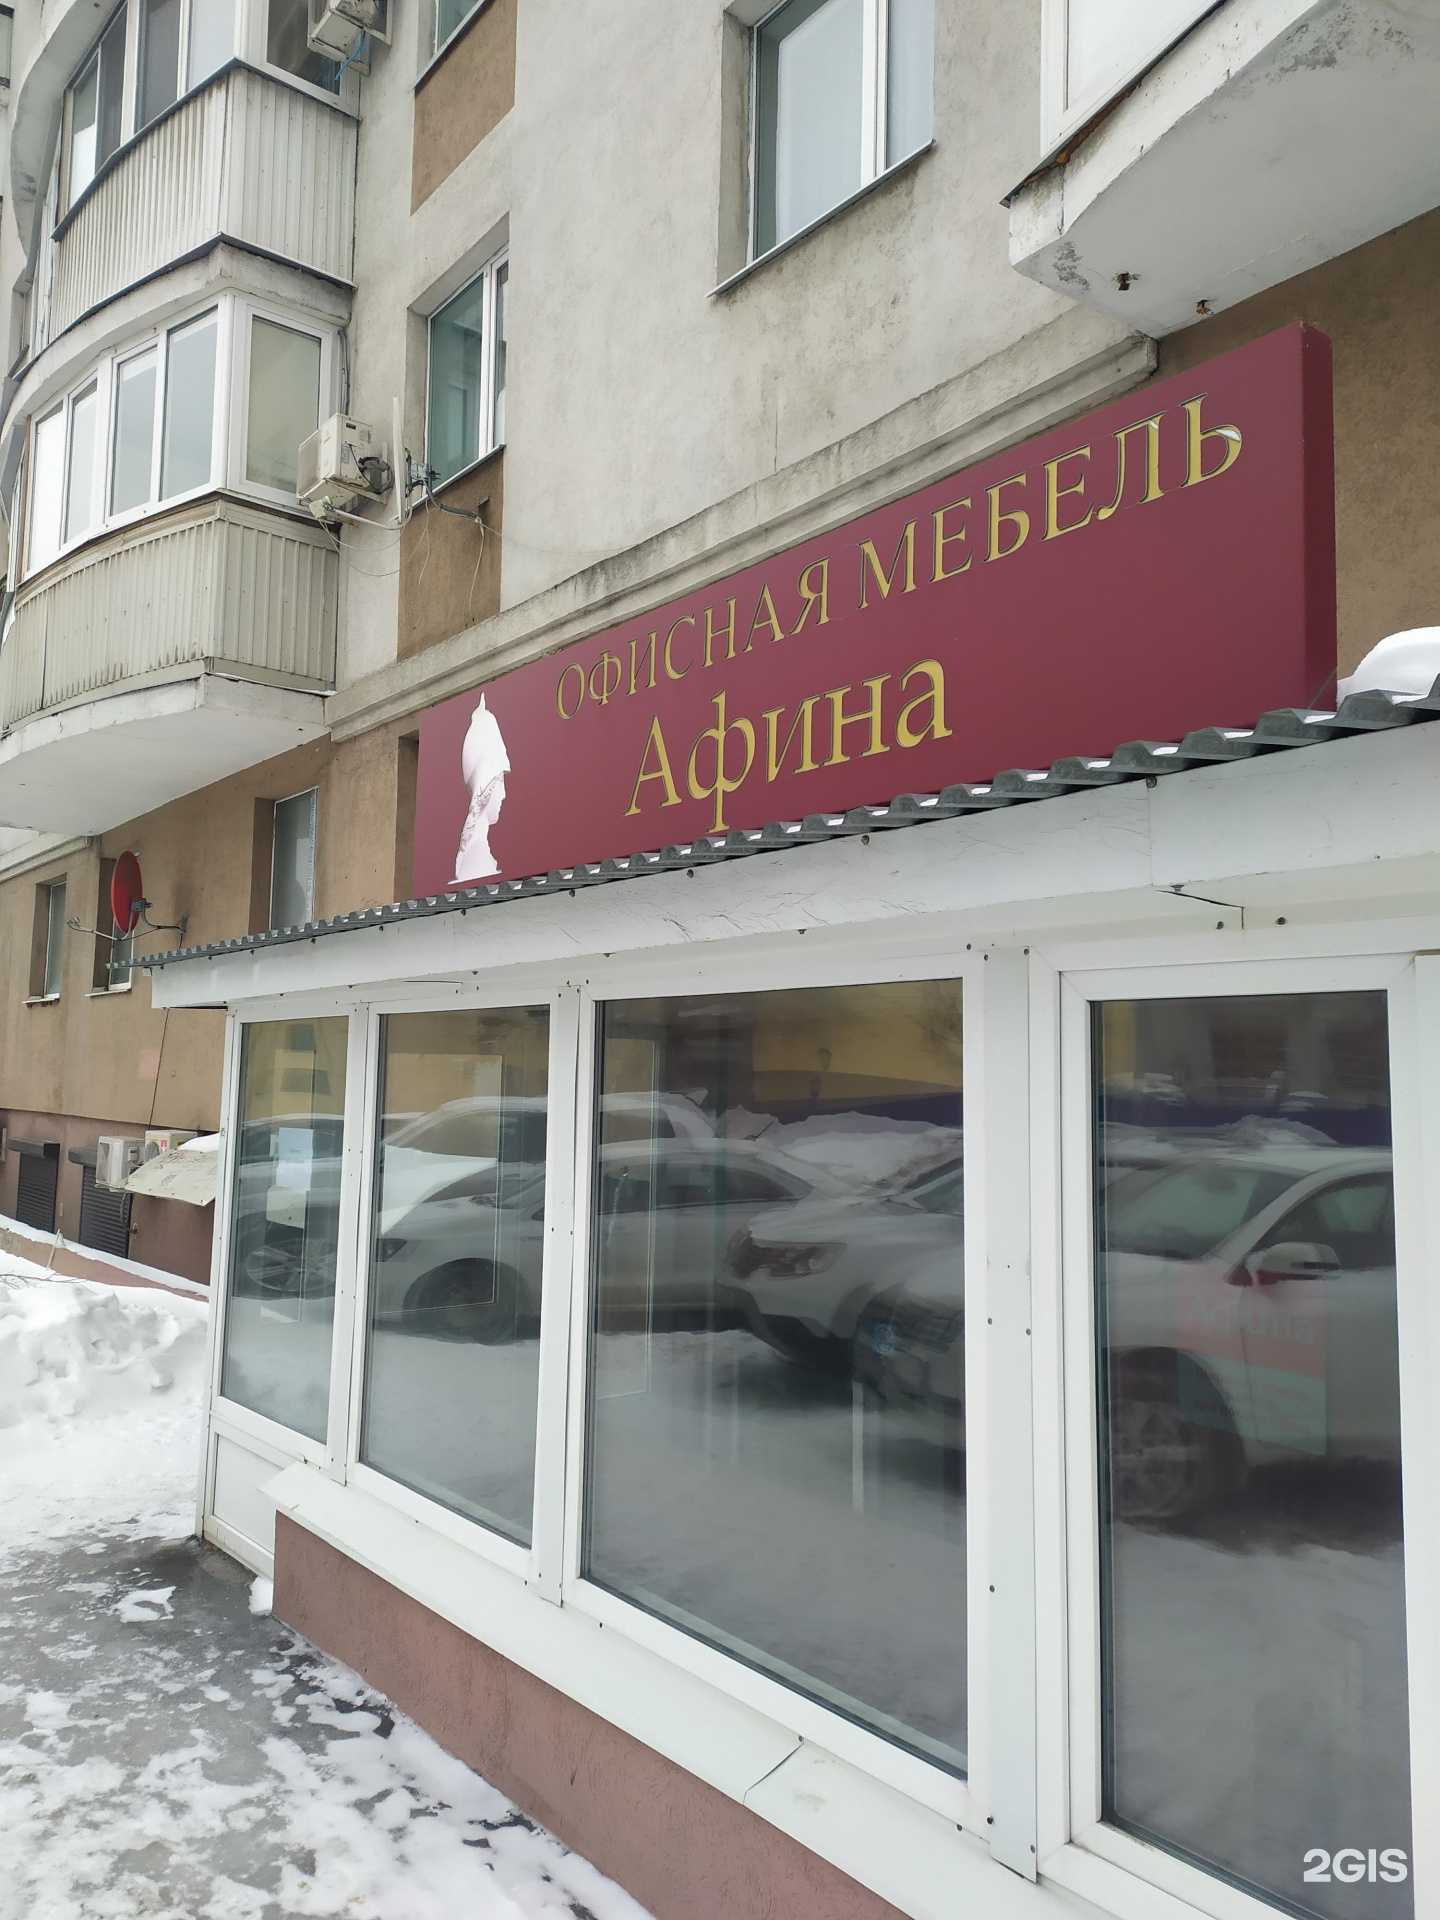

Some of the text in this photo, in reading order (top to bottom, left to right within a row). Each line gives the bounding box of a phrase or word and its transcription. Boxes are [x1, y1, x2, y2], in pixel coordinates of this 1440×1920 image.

[555, 393, 1244, 720] ОФИСНАЯ МЕБЕЛЬ
[624, 658, 954, 833] Афина
